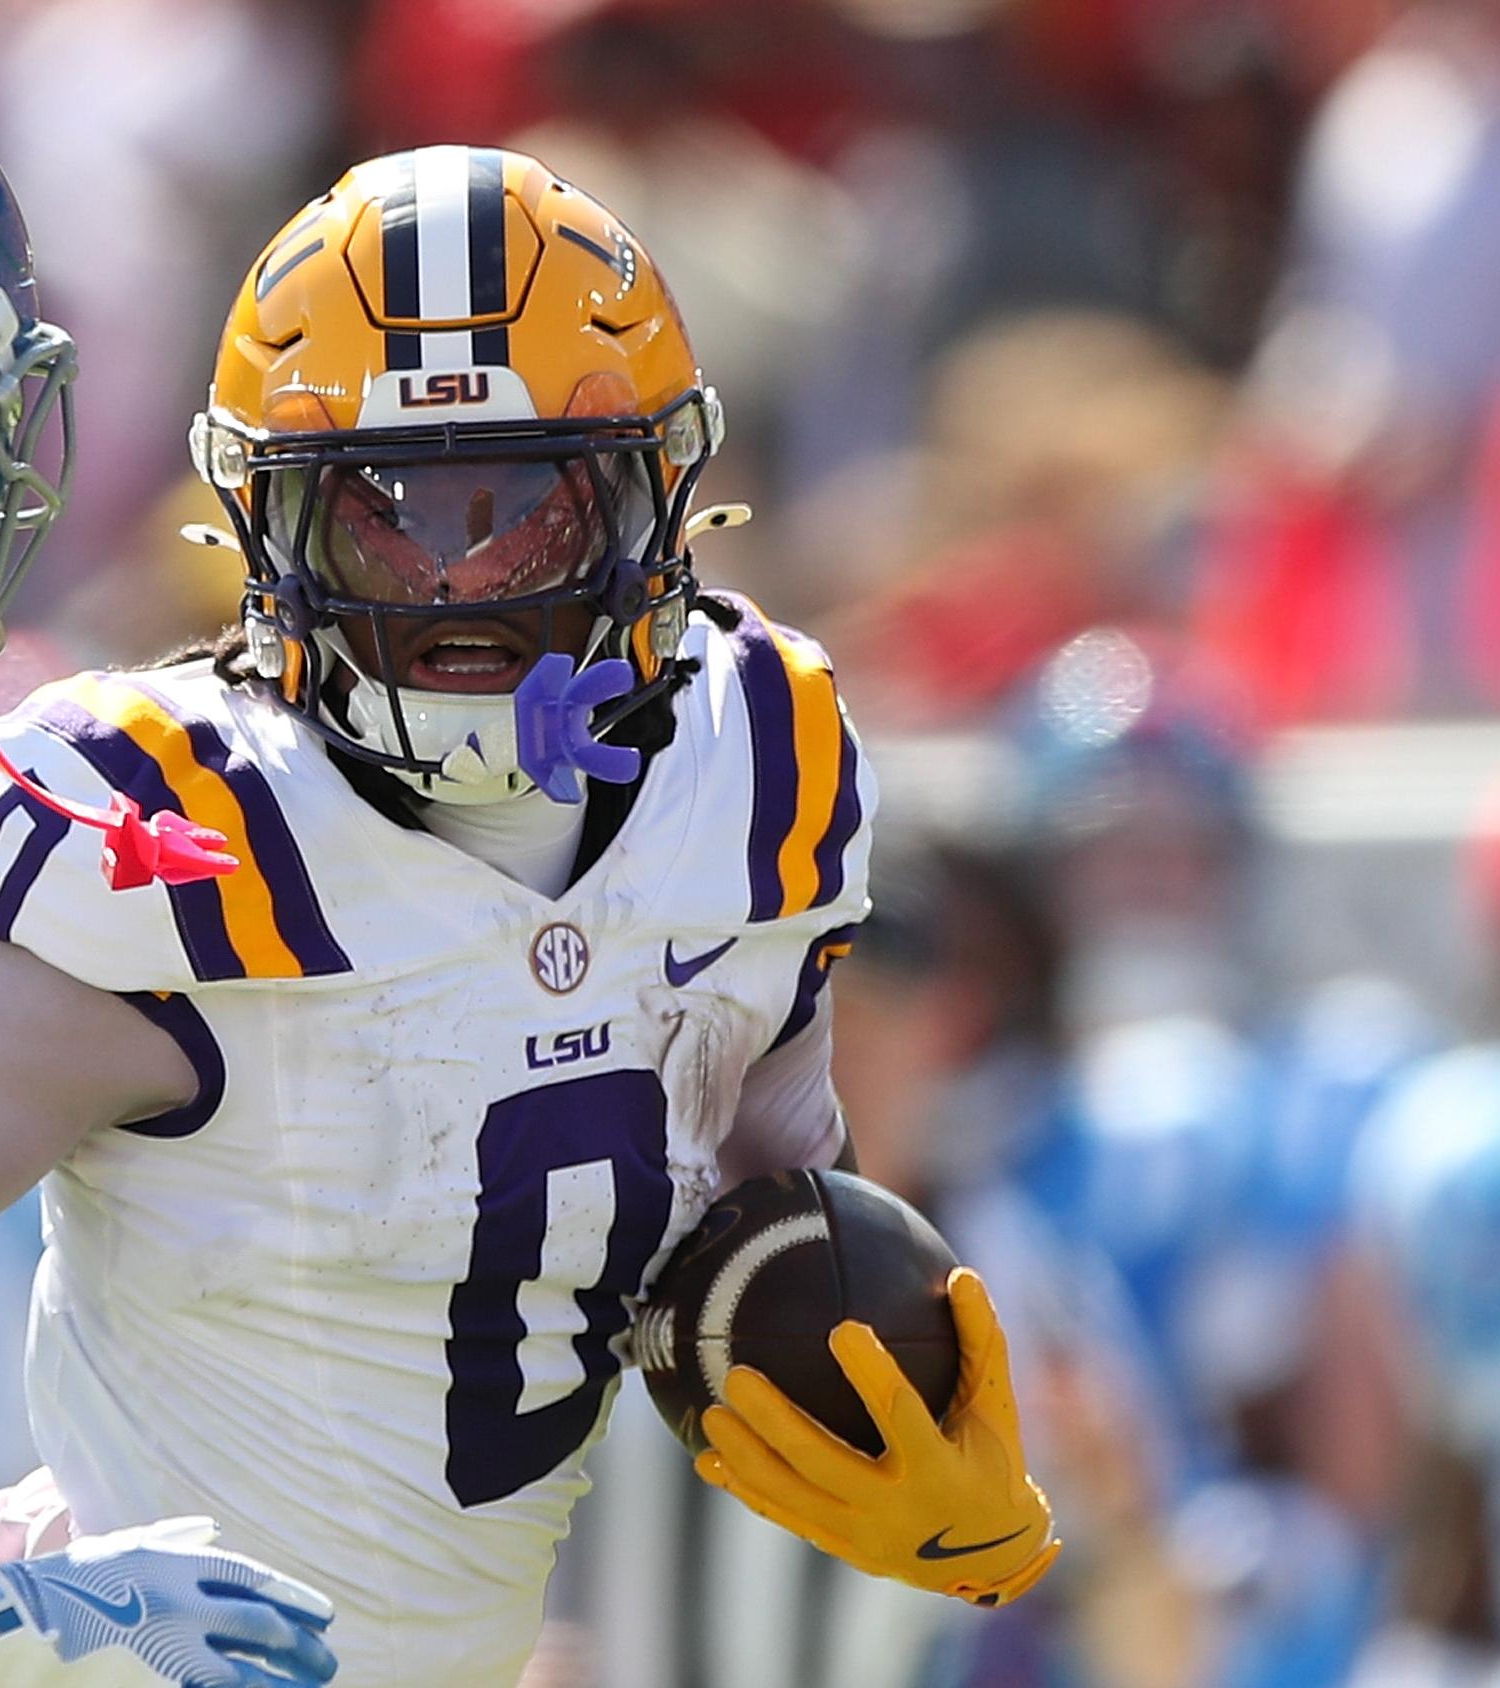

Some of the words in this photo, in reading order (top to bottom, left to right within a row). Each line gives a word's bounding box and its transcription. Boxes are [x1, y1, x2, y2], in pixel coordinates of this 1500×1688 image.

[399, 372, 489, 408] LSU
[534, 925, 587, 992] SEC
[525, 1020, 612, 1070] LSU
[444, 1068, 674, 1510] 0
